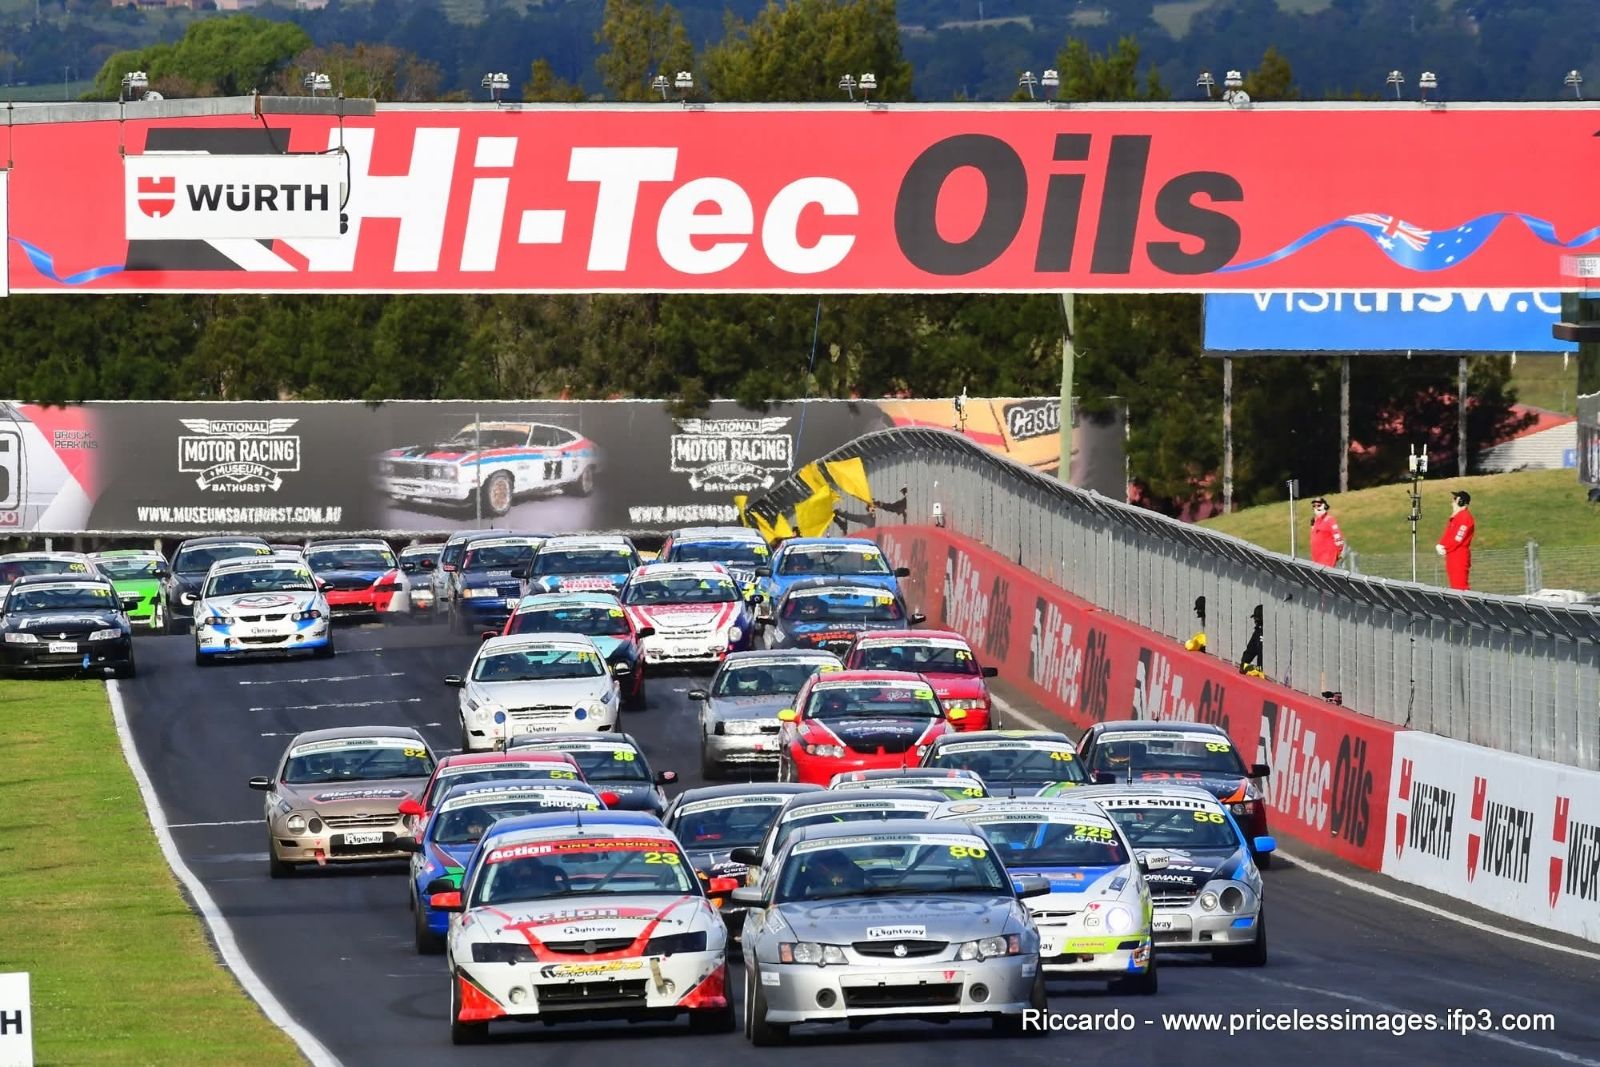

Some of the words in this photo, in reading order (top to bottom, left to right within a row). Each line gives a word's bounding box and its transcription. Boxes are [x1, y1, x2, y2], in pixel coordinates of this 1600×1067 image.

[186, 184, 328, 211] WÜRTH
[309, 127, 859, 275] Hi-Tec
[894, 133, 1245, 276] Oils
[212, 422, 267, 432] NATIONAL
[703, 421, 760, 432] NATIONAL
[184, 440, 235, 462] MOTOR
[239, 440, 294, 461] RACING
[676, 439, 727, 462] MOTOR
[731, 439, 786, 461] RACING
[215, 463, 264, 475] MUSEUM
[211, 483, 266, 492] BATHURST
[137, 506, 342, 524] WWW.MUSEUMSBATHURST.COM.AU
[1044, 603, 1081, 707] Hi-Tec
[1080, 627, 1110, 721] Oils
[403, 748, 427, 758] 82
[1205, 743, 1230, 753] 93
[1049, 752, 1073, 761] 49
[1277, 705, 1330, 831] Hi-Tec
[1330, 734, 1372, 848] Oils
[1193, 811, 1225, 824] 56
[1410, 781, 1456, 860] WÜRTH
[1074, 824, 1113, 840] 225
[1065, 835, 1118, 847] J.CALLO
[1483, 800, 1534, 883] WÜRTH
[491, 846, 552, 860] Action
[645, 852, 680, 864] 23
[949, 845, 986, 859] 80
[564, 926, 617, 935] Rightway
[870, 928, 924, 938] Rightway
